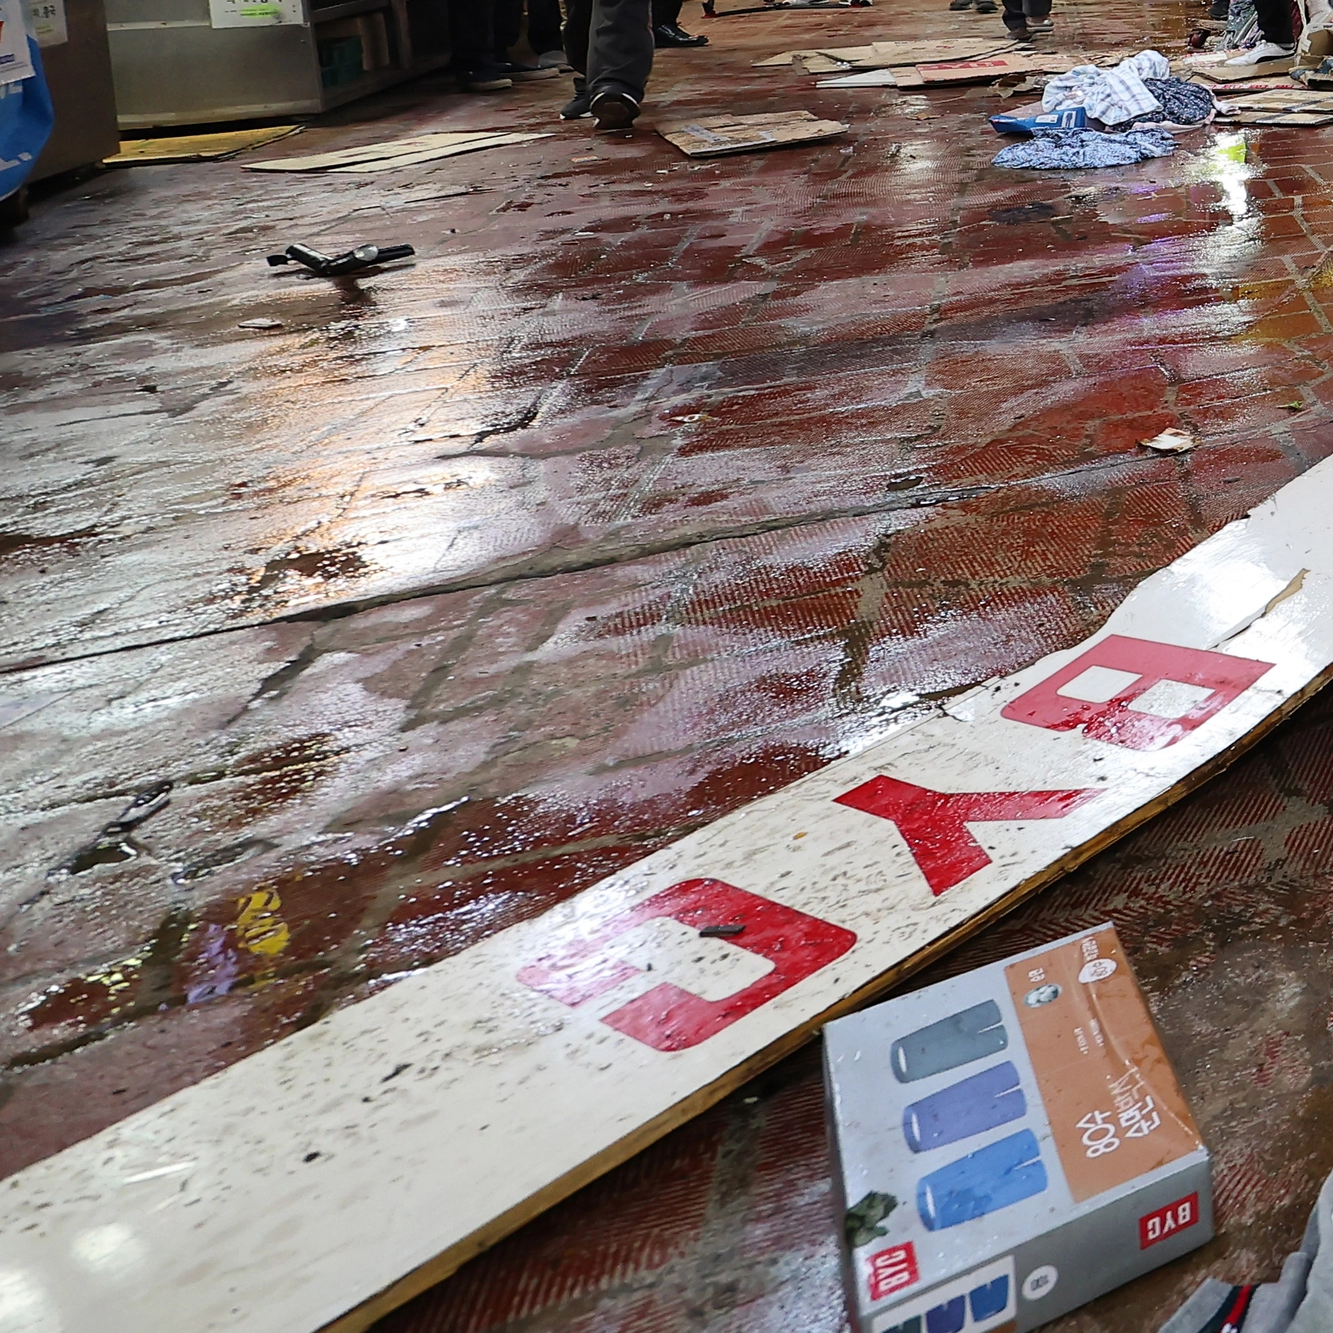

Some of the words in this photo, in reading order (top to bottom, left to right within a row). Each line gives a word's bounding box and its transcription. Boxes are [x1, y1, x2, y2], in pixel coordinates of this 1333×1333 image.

[514, 634, 1277, 1052] BYC
[1075, 1109, 1121, 1158] 80수
[1147, 1201, 1192, 1240] BYC
[875, 1249, 911, 1291] BYC
